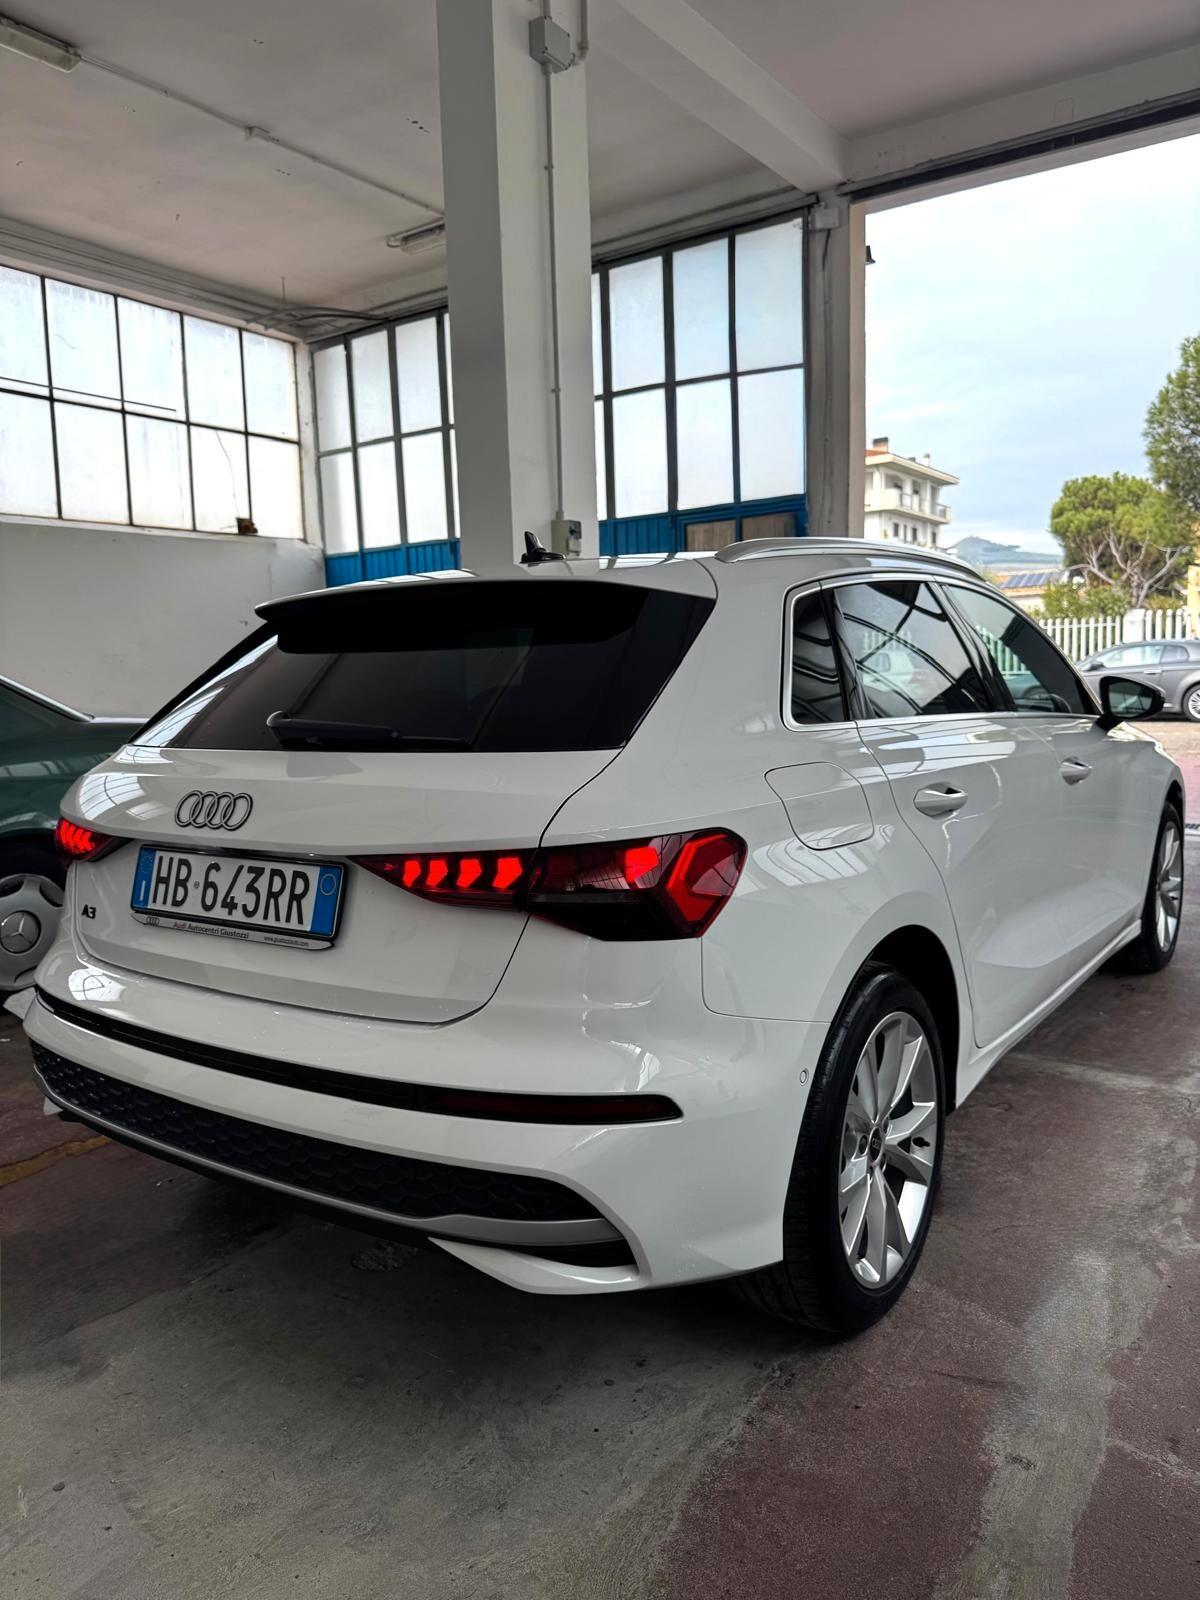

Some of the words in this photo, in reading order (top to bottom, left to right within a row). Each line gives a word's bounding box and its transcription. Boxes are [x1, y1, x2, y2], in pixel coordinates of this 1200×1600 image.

[152, 855, 192, 907] HB
[201, 862, 310, 925] 643RR
[81, 905, 96, 920] A3
[173, 920, 187, 931] Audi
[187, 922, 219, 934] Autocentri
[220, 928, 249, 939] Giustozzi
